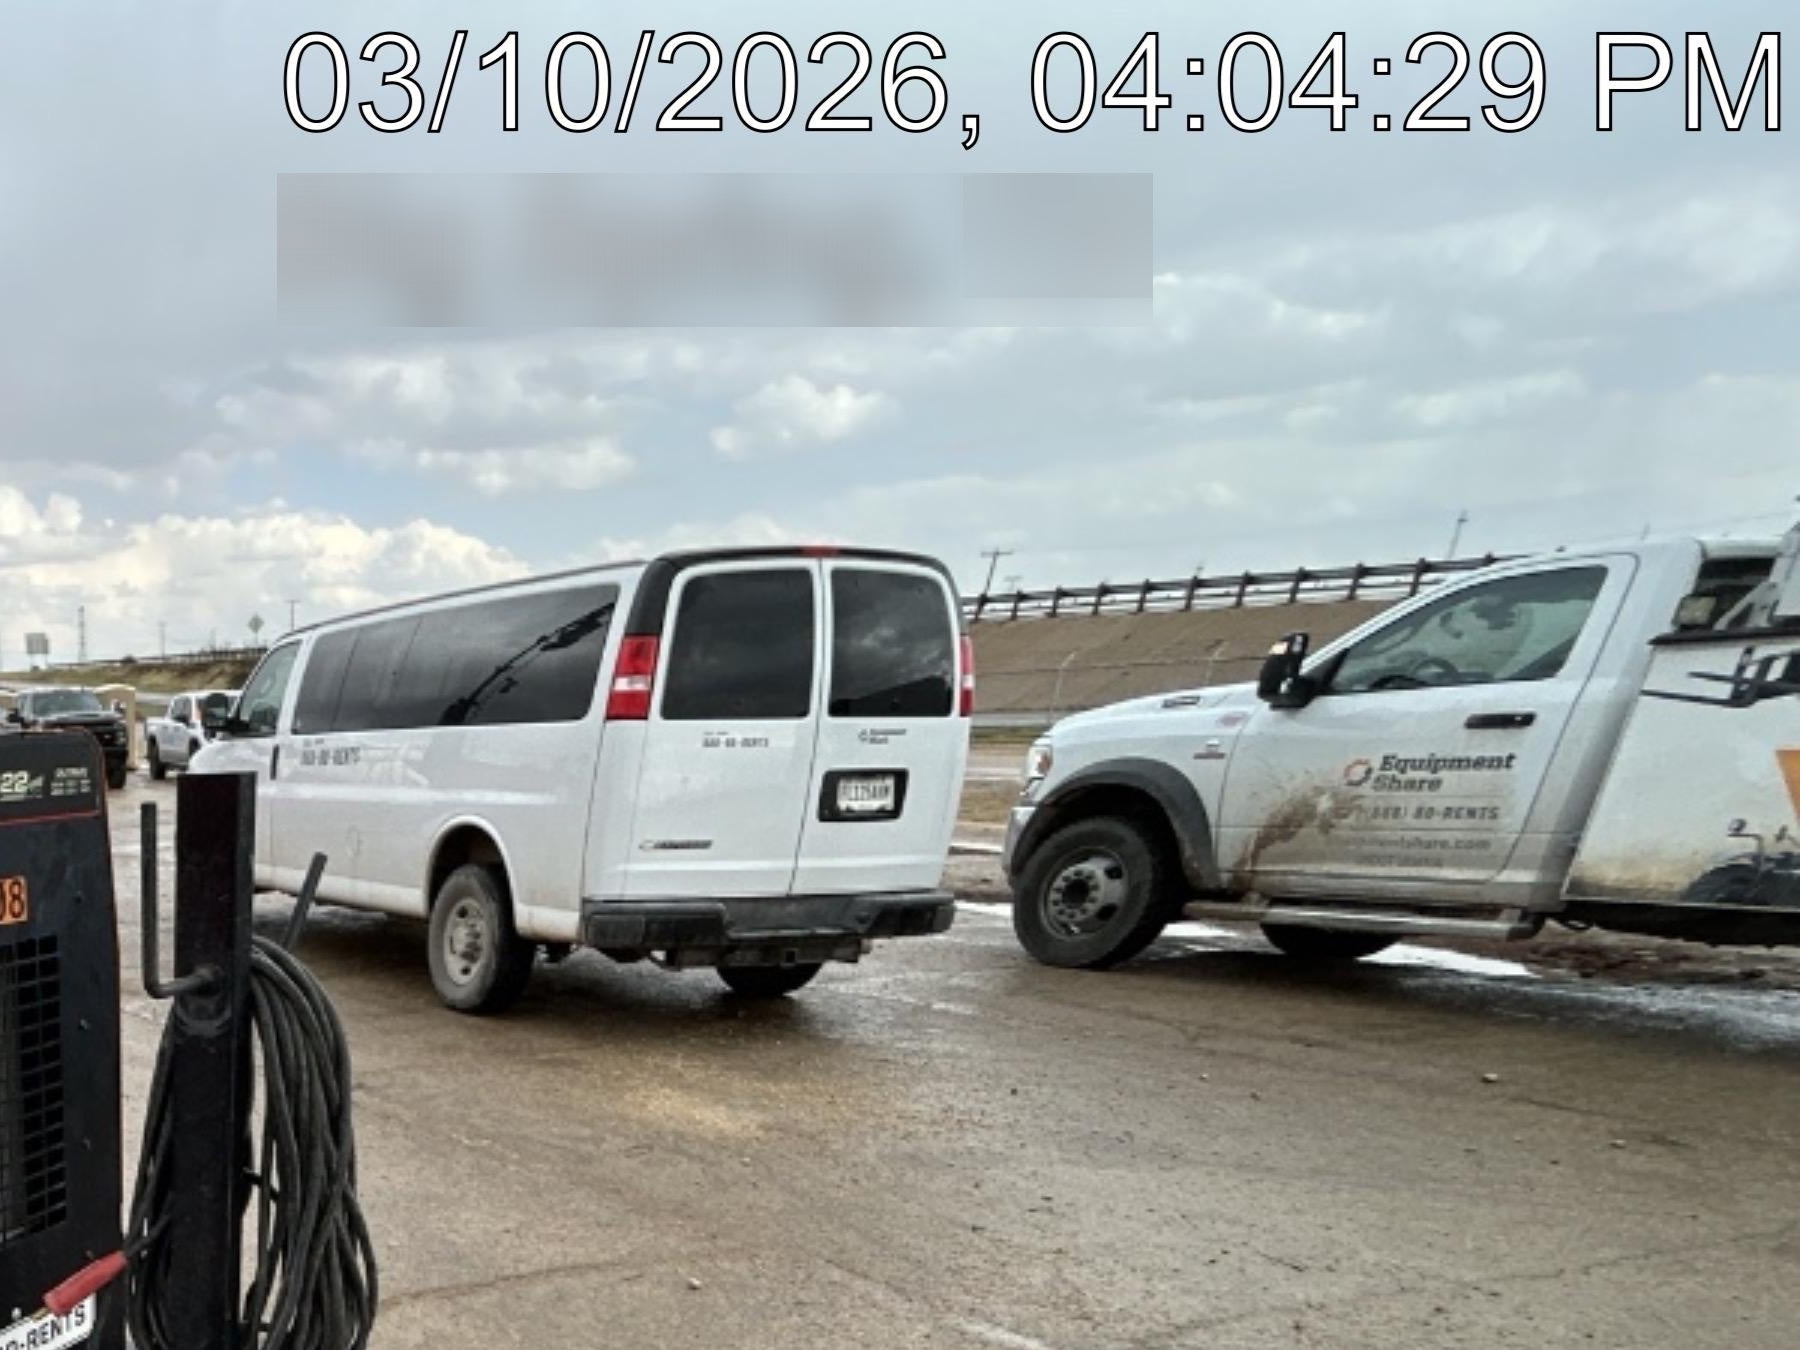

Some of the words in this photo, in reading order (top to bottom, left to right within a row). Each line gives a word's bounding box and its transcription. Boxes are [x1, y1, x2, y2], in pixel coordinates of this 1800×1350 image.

[1379, 752, 1517, 774] Equipment
[1371, 774, 1443, 793] Share
[1413, 805, 1500, 821] 80-RENTS
